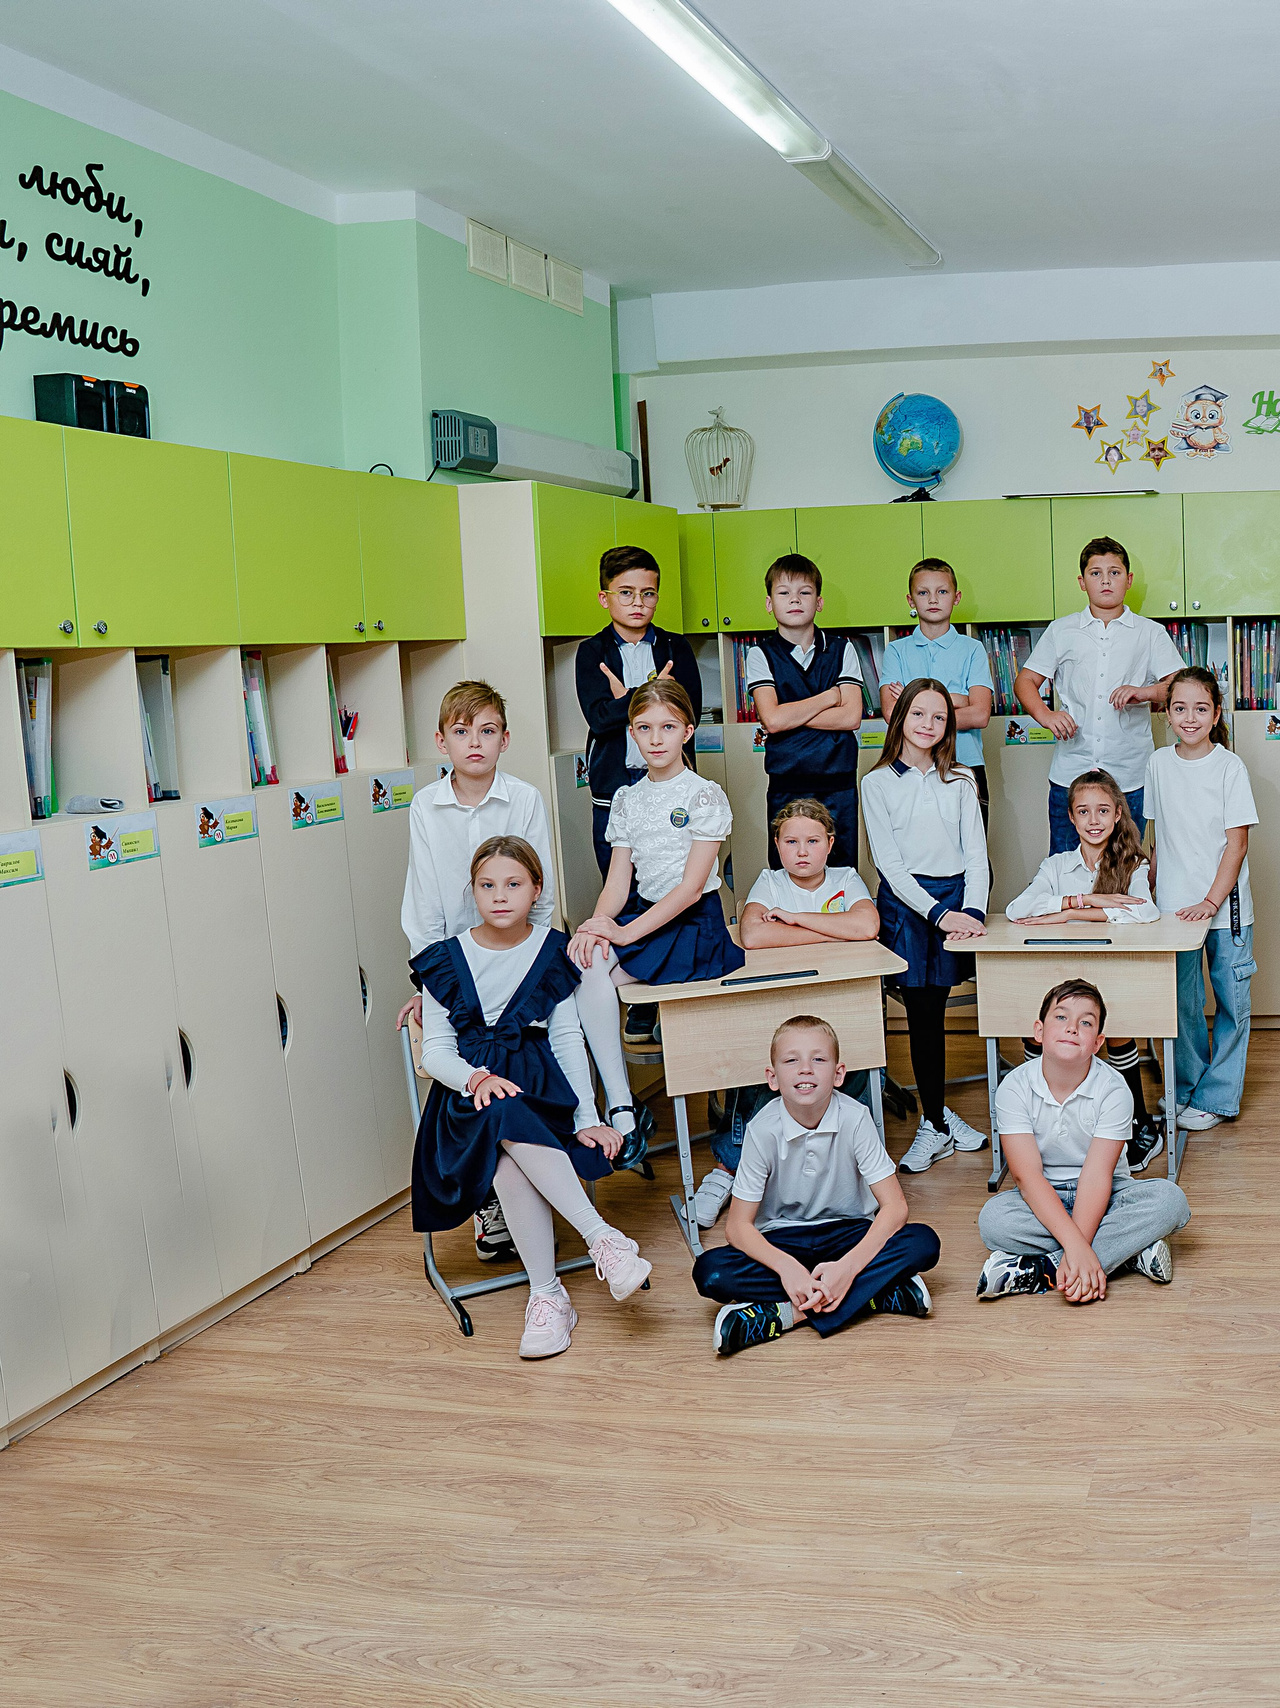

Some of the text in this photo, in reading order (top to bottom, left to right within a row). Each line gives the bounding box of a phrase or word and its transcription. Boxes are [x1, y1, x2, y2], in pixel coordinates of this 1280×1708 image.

[18, 163, 143, 238] люби,
[45, 232, 150, 298] сияй,
[109, 852, 117, 861] М
